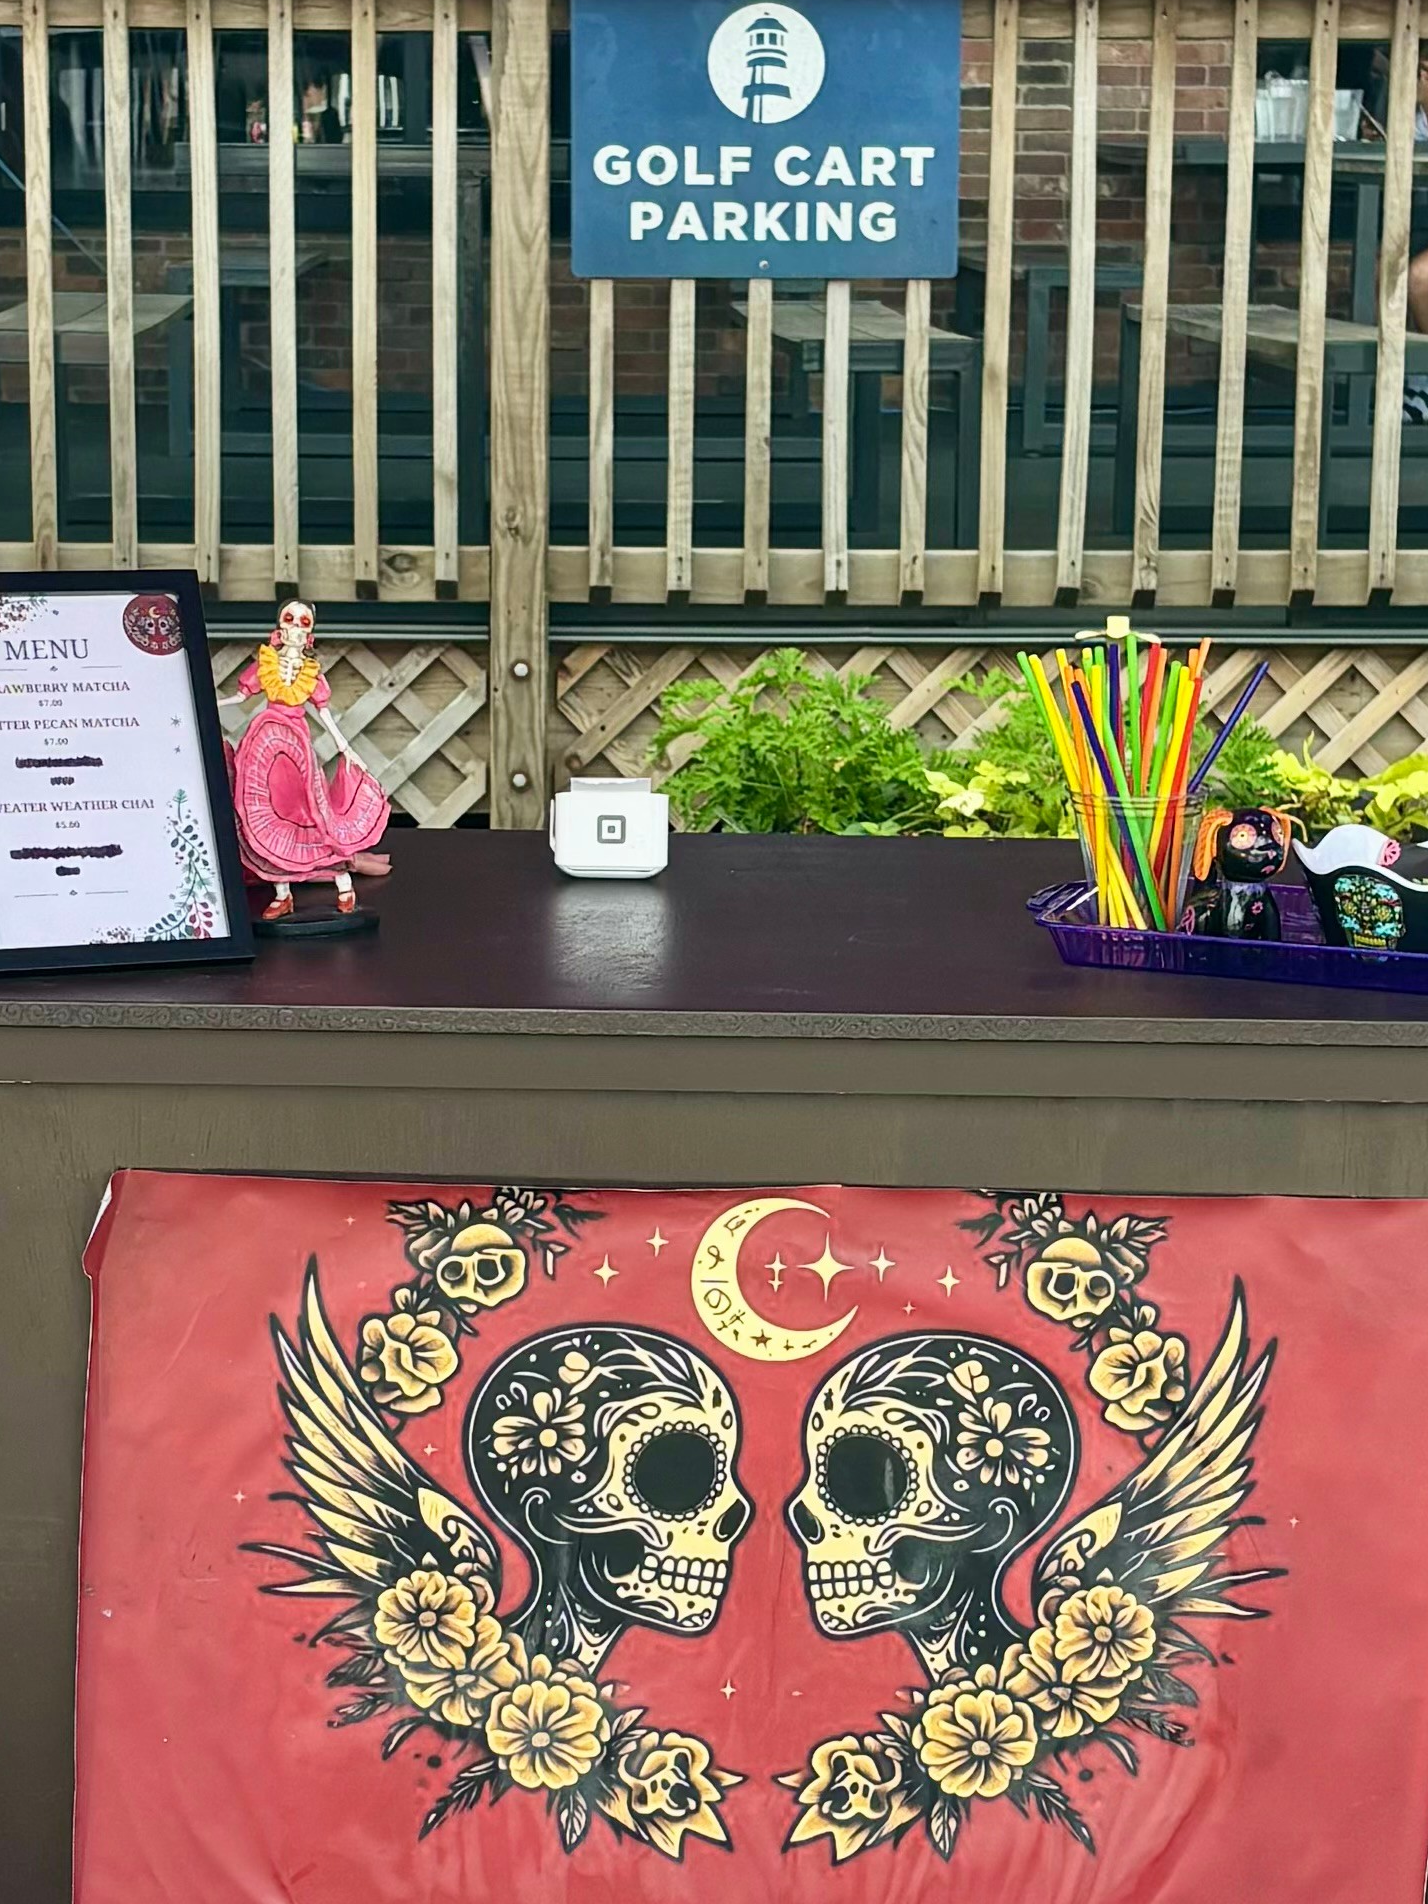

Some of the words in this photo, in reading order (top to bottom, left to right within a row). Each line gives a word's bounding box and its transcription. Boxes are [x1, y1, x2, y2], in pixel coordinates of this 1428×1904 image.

[592, 143, 753, 186] GOLF
[773, 144, 936, 187] CART
[629, 200, 898, 243] PARKING
[4, 638, 90, 661] MENU
[72, 680, 131, 693] MATCHA
[38, 699, 63, 708] $7.00
[34, 718, 79, 730] PECAN
[81, 716, 141, 729] MATCHA
[43, 737, 69, 746] $7.00
[50, 799, 119, 812] WEATHER
[121, 798, 156, 810] CHAI
[55, 820, 81, 829] $5.00
